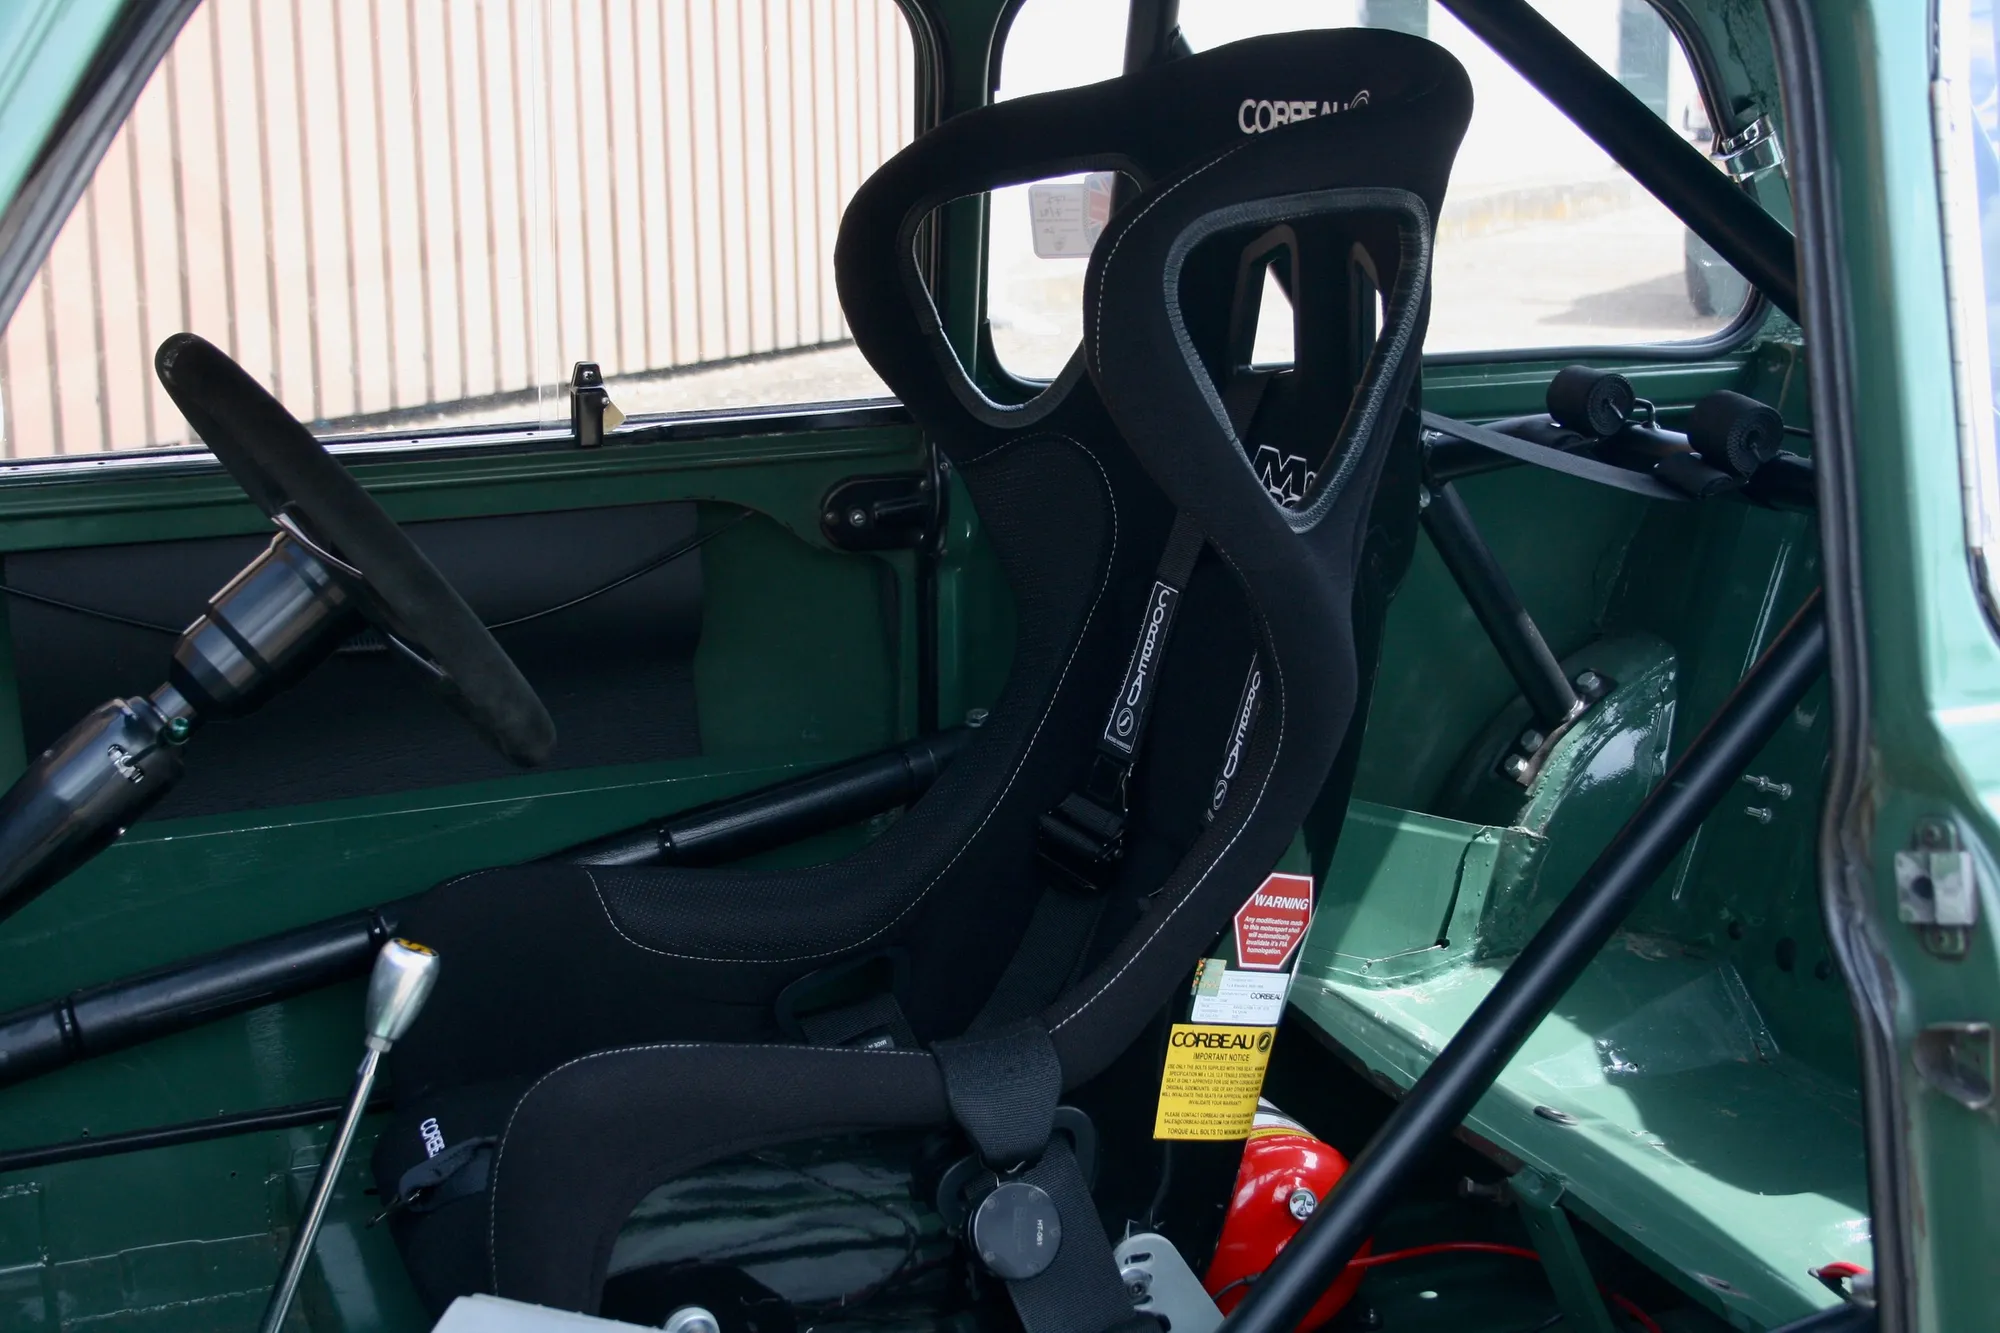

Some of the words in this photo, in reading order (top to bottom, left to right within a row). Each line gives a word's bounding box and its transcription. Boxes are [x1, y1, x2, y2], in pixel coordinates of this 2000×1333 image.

[1126, 589, 1170, 706] CORBEAU
[1223, 670, 1261, 779] ORBEAU
[1254, 894, 1309, 910] WARNING
[1256, 917, 1289, 925] modifications
[1258, 933, 1290, 941] automatically
[1250, 992, 1282, 1000] CORBEAU
[1172, 1031, 1255, 1049] CORBEAU
[1193, 1052, 1228, 1061] IMPORTANT
[1229, 1053, 1250, 1061] NOTICE
